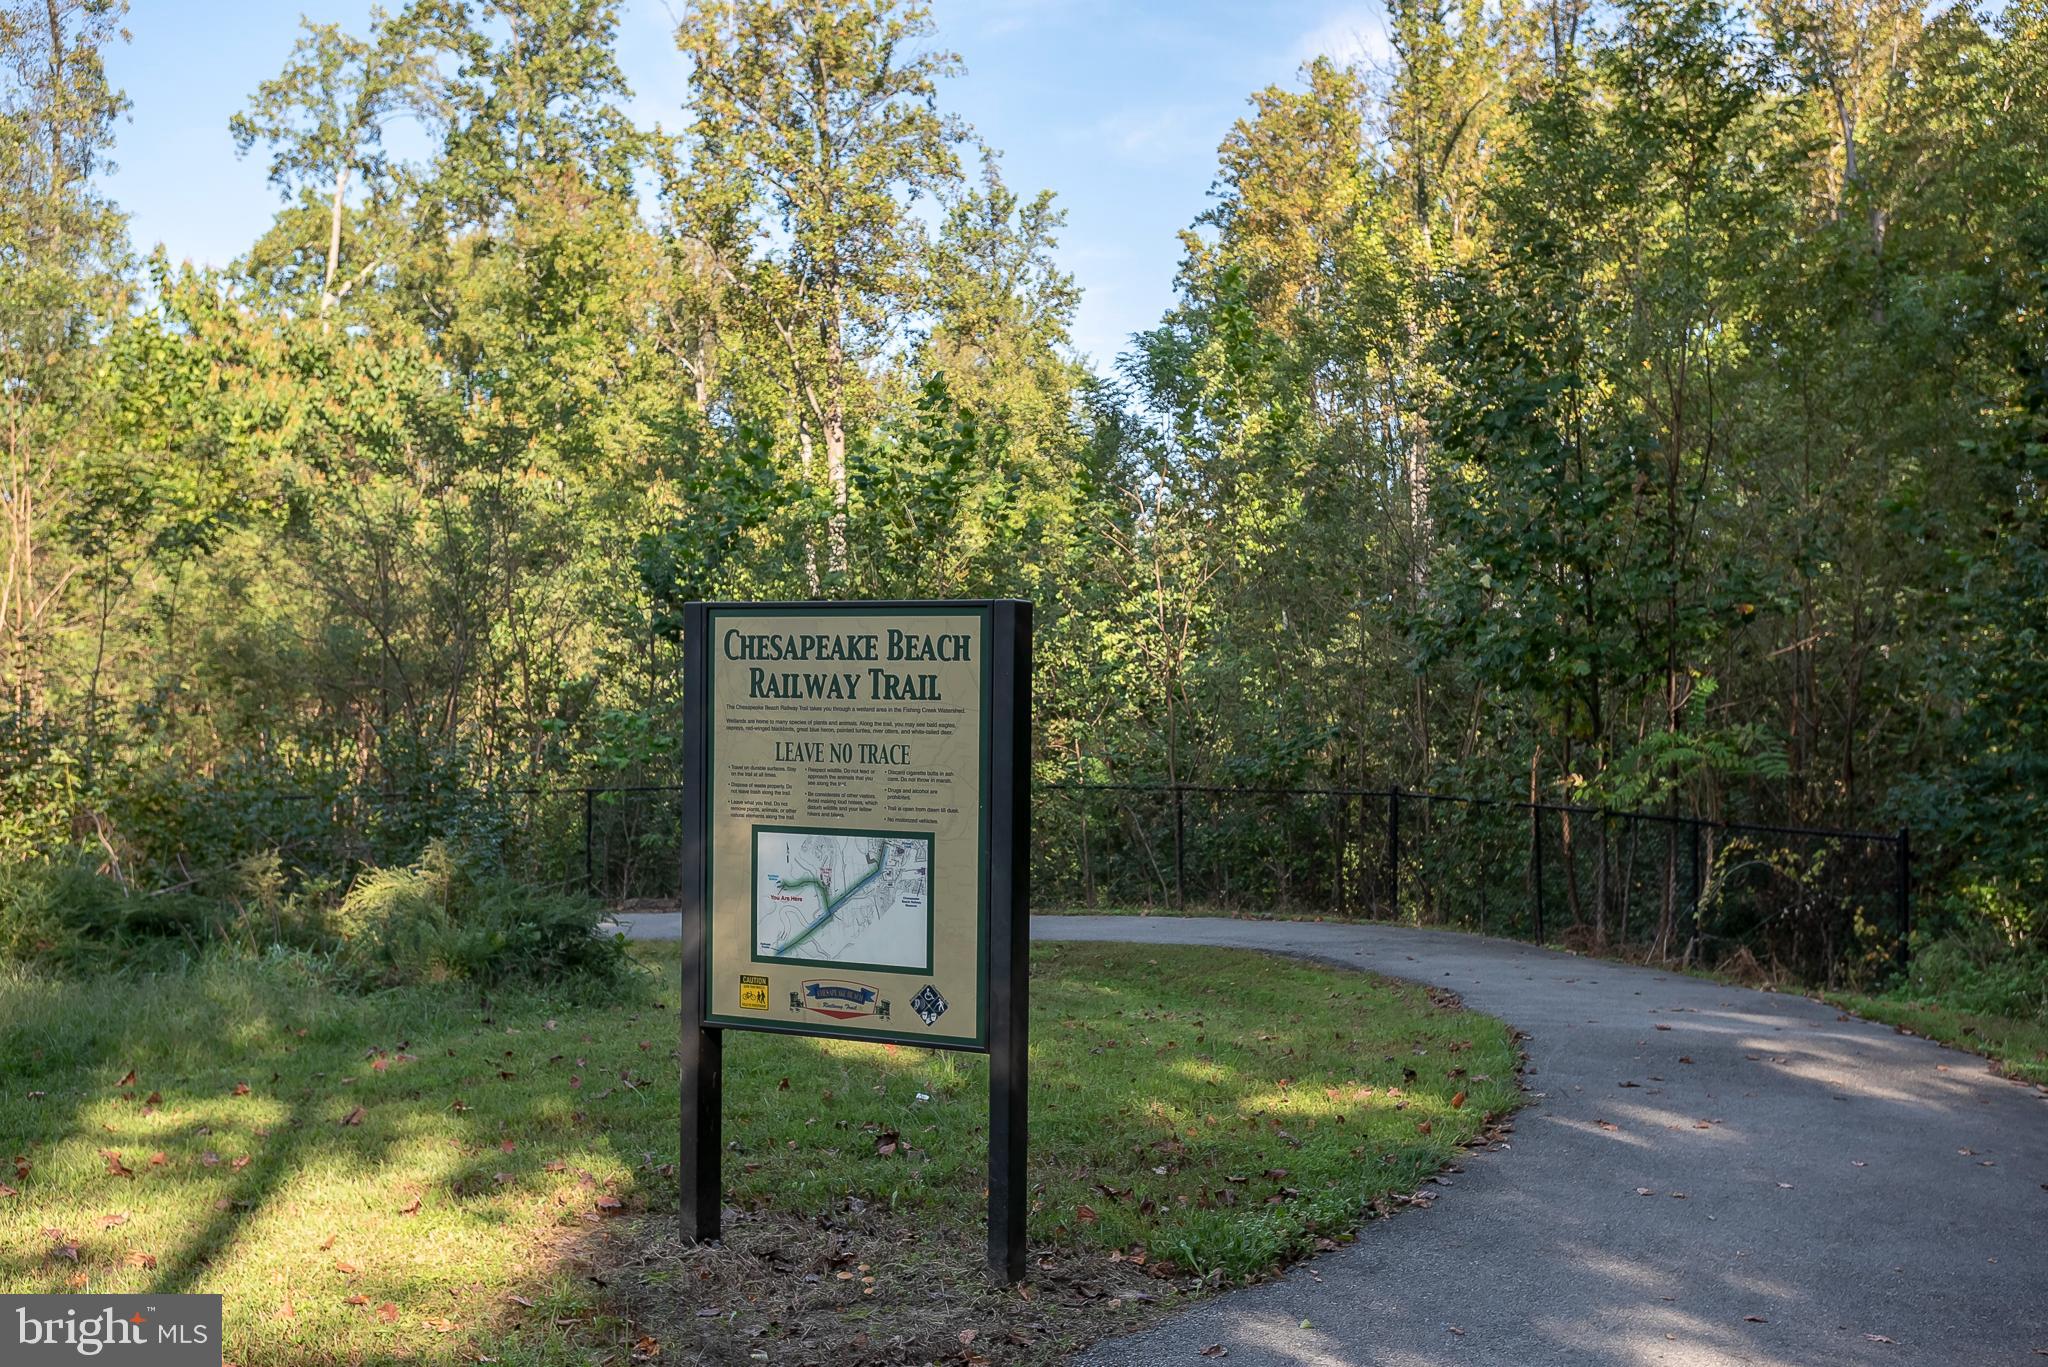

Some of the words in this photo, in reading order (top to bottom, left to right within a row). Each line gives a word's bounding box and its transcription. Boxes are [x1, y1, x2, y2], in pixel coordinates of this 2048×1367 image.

[724, 629, 879, 661] CHESAPEAKE
[887, 629, 971, 661] BEACH
[750, 668, 860, 699] RAILWAY
[868, 669, 941, 700] TRAIL
[776, 742, 824, 762] LEAVE
[830, 743, 852, 763] NO
[858, 744, 910, 765] TRACE
[743, 976, 766, 984] CAUTION
